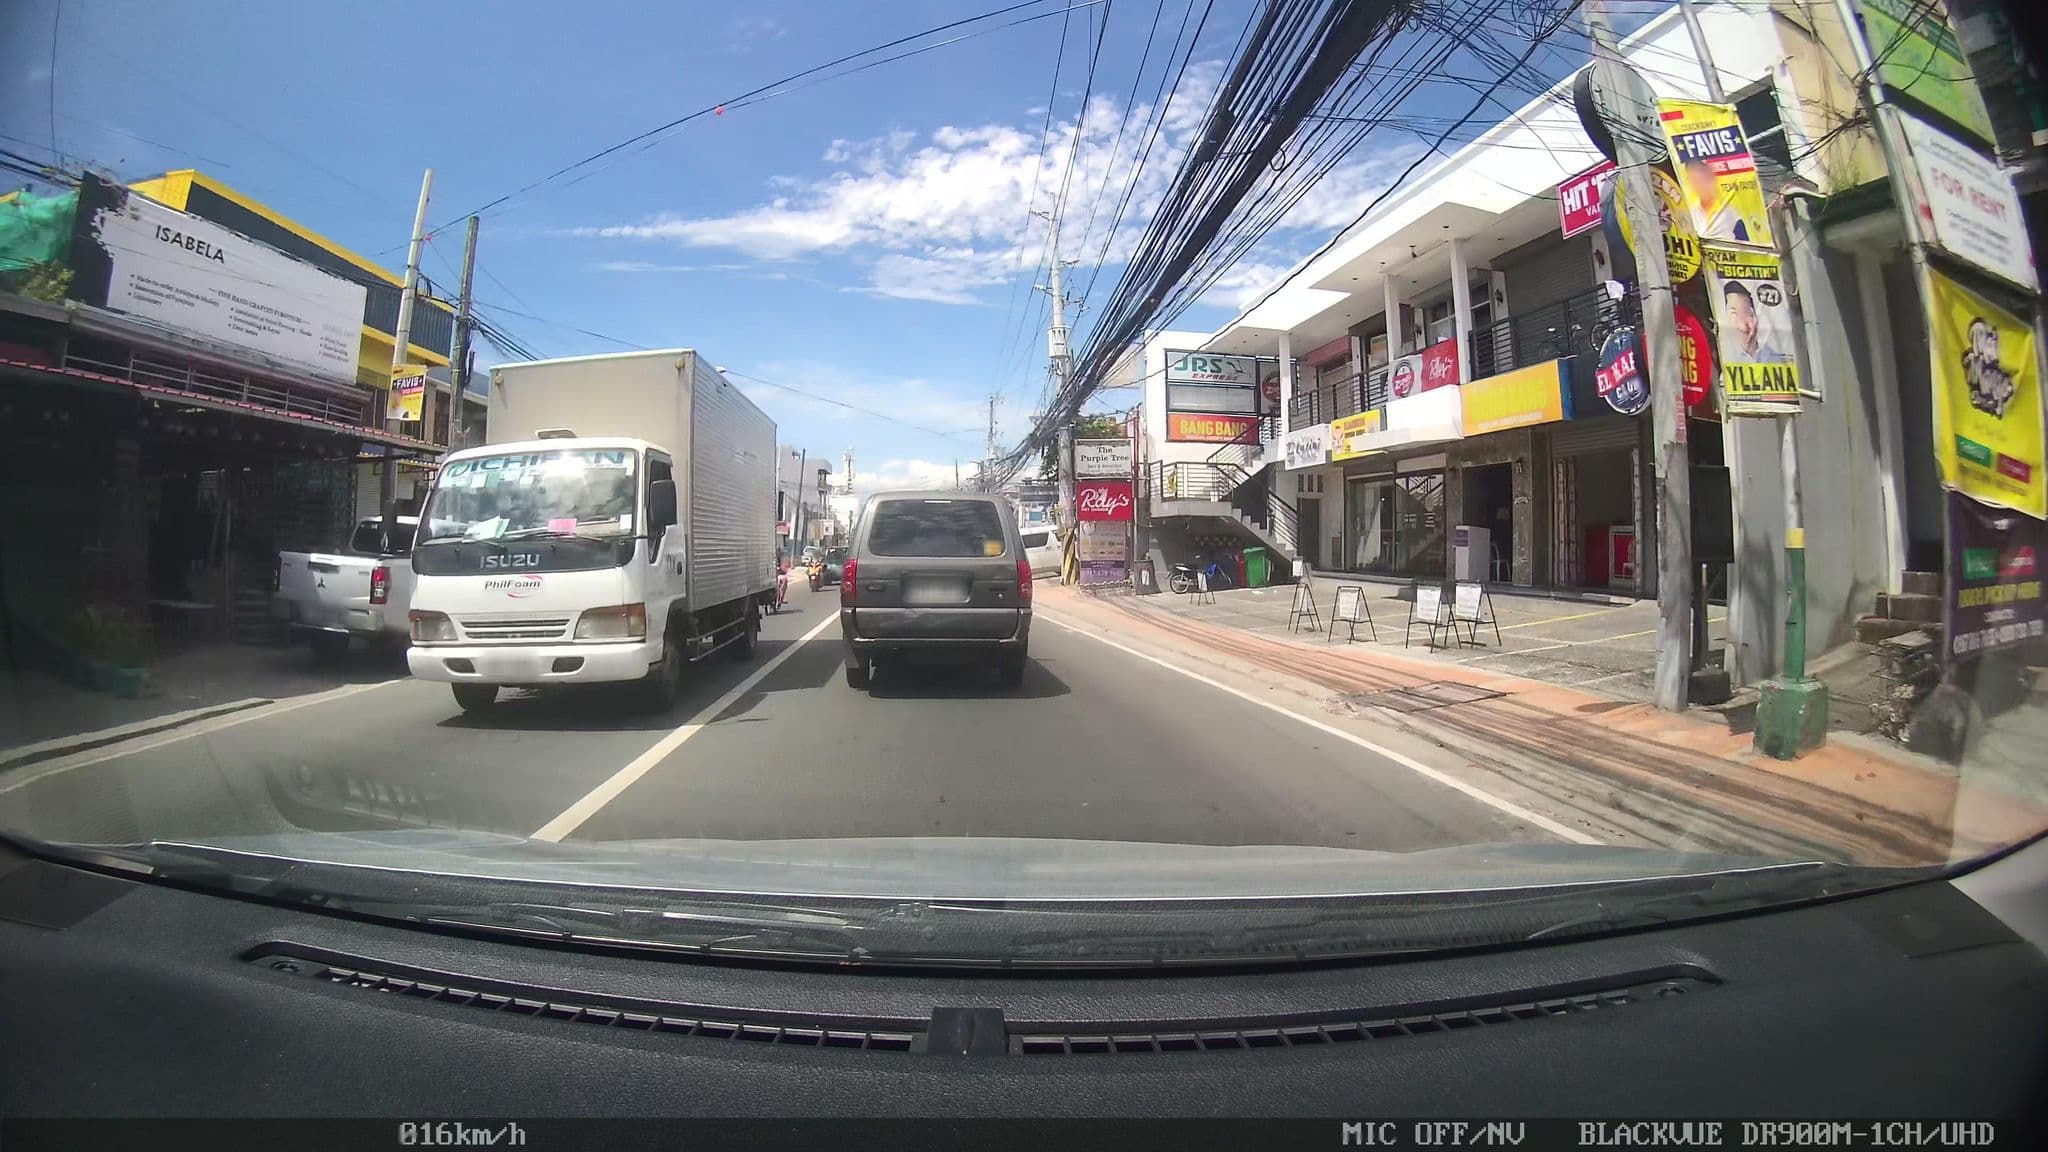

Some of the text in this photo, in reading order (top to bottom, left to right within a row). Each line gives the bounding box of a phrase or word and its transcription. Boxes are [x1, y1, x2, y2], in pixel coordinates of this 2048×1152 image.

[1683, 130, 1735, 157] FAVIS
[1562, 180, 1589, 215] HIT
[1931, 167, 1964, 198] FOR
[1969, 187, 2006, 221] RENT
[155, 225, 225, 263] ISABELA
[1174, 355, 1223, 374] JRS
[396, 377, 419, 389] FAVIS
[1192, 373, 1239, 381] EXPRESS
[1725, 366, 1797, 391] YLLANA
[1180, 421, 1249, 437] BANG BANG
[1097, 446, 1113, 454] The
[1081, 454, 1109, 464] Purple
[480, 553, 540, 569] ISUZU
[484, 580, 541, 590] PhilFoam
